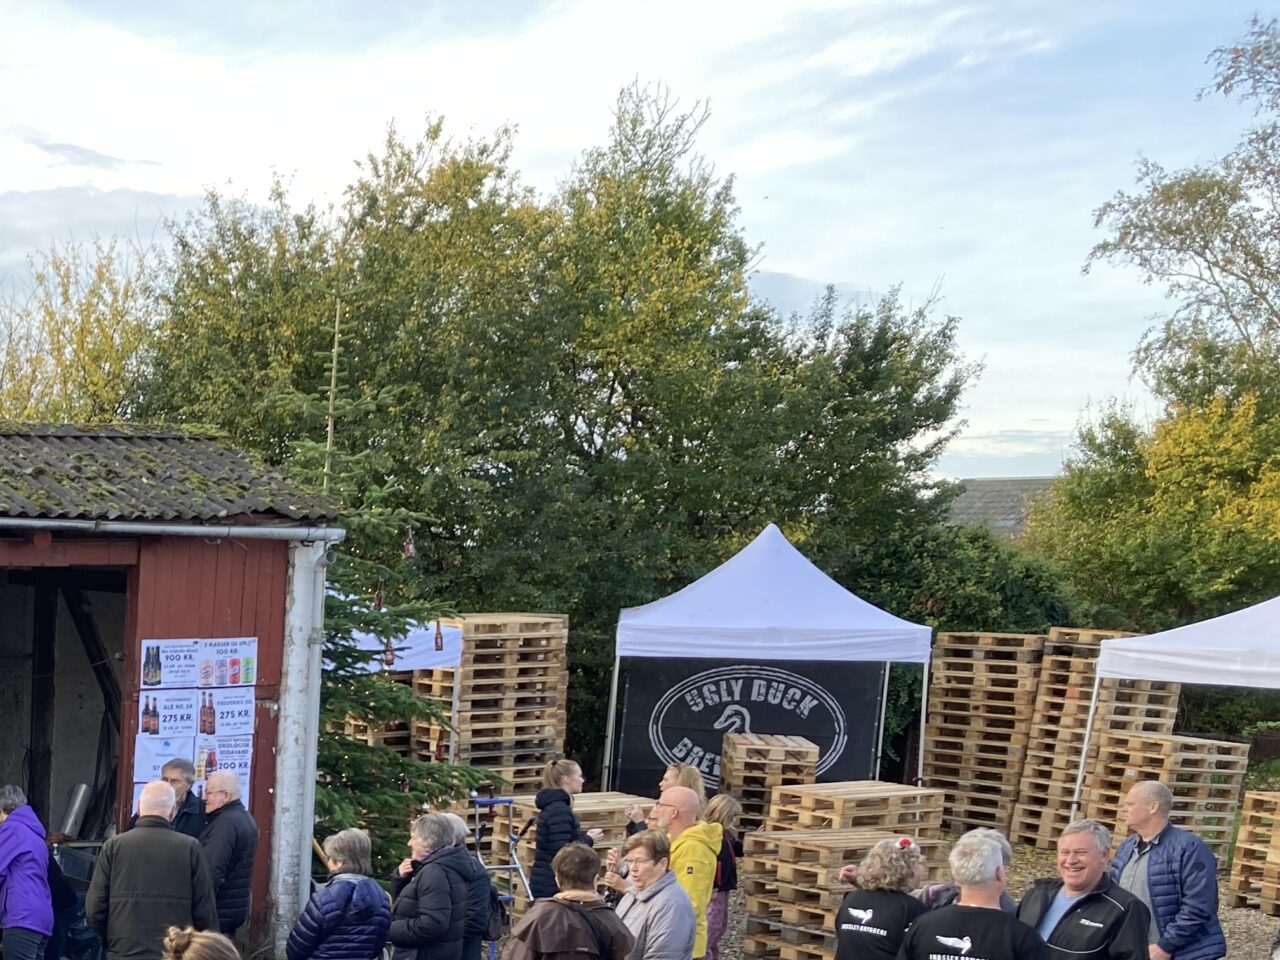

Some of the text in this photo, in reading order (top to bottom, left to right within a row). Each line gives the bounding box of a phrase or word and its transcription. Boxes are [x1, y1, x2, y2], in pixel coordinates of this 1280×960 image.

[684, 678, 819, 719] UGLY DUCK
[163, 714, 178, 722] 275
[220, 710, 251, 720] 275 KR.
[218, 762, 237, 770] 200
